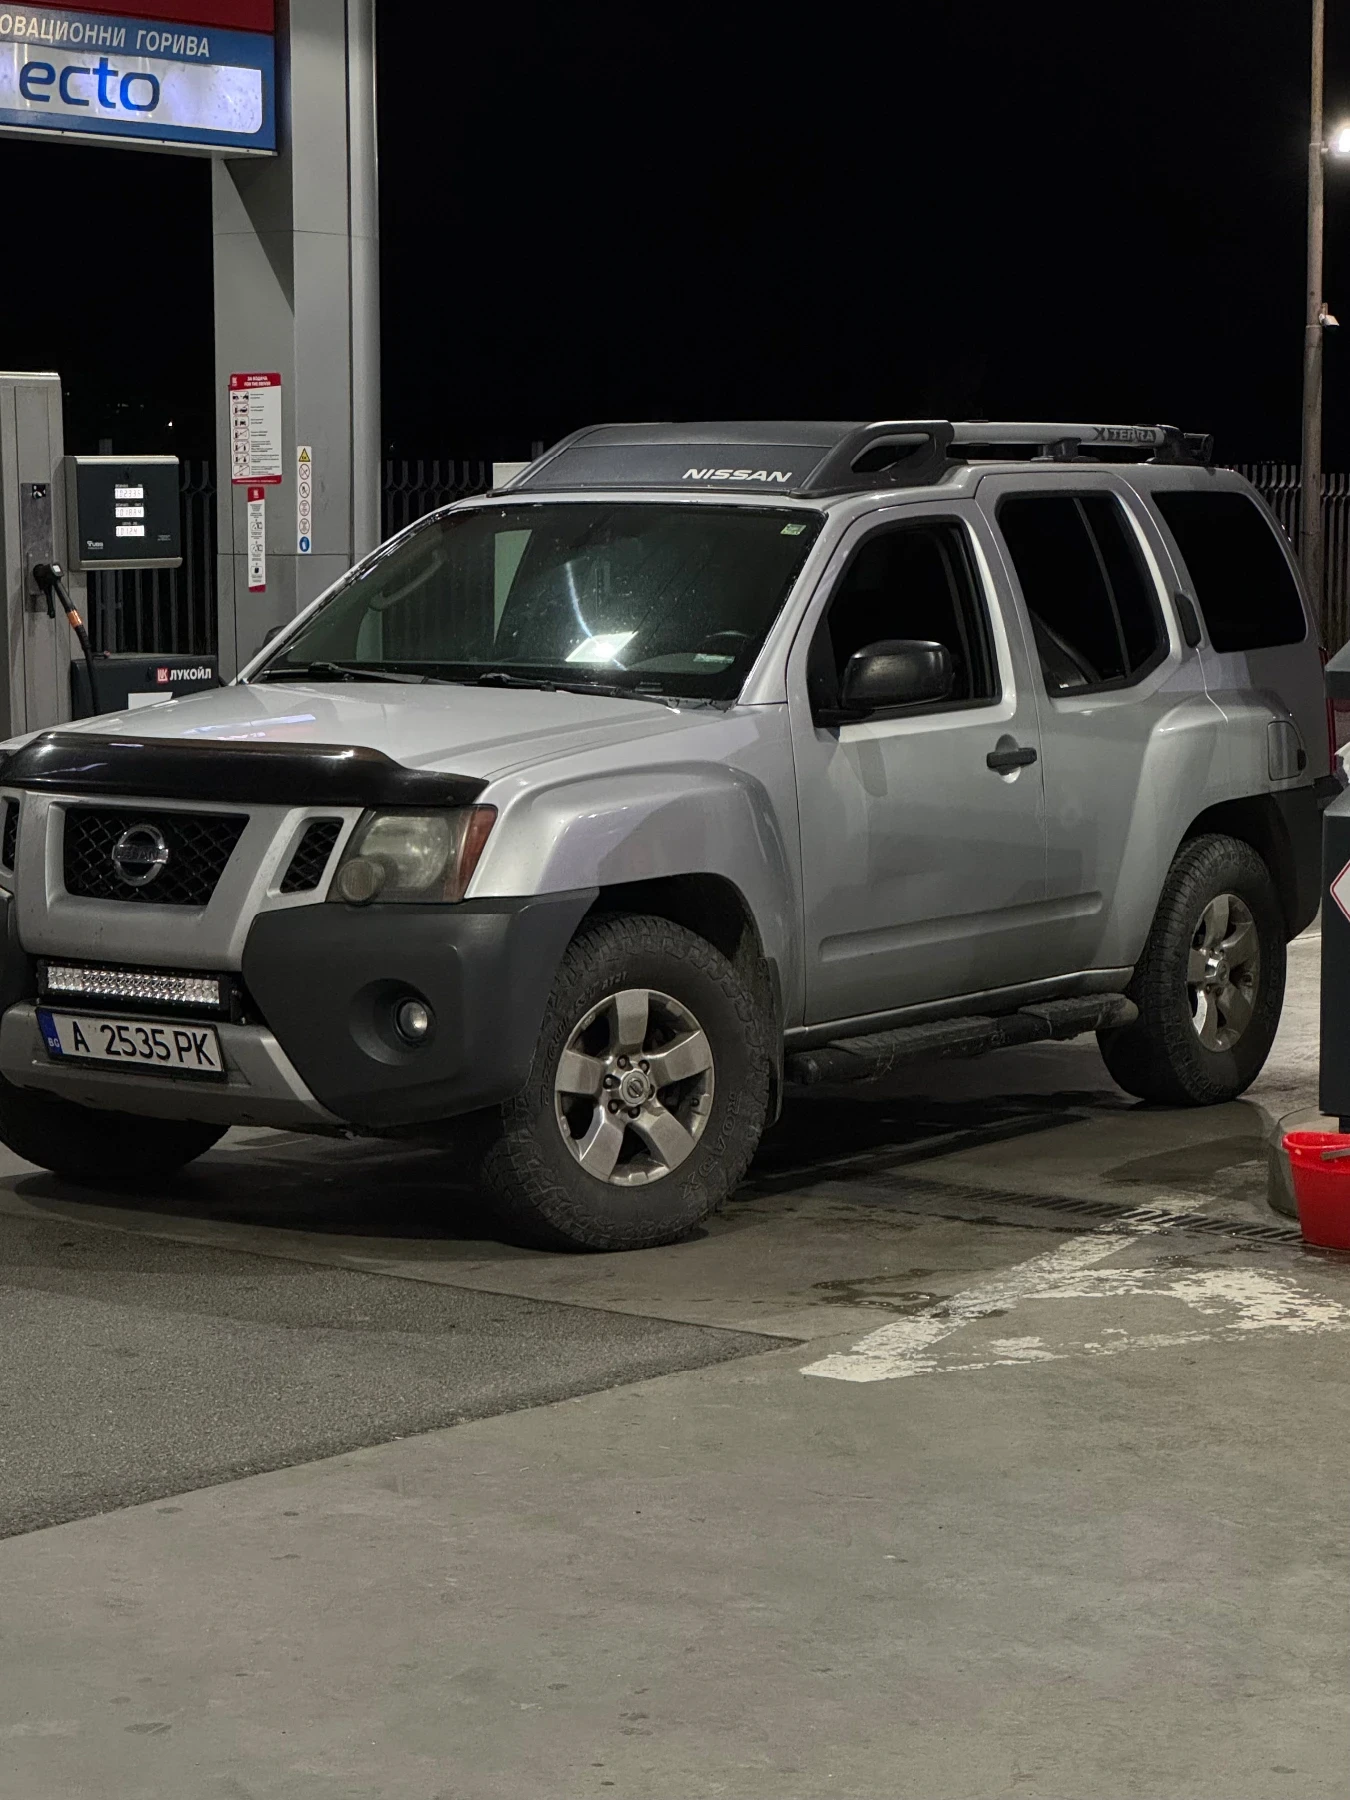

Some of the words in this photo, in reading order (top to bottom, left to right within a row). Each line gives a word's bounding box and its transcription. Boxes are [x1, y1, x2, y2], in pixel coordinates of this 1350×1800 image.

[136, 29, 210, 58] ГОРИВА
[19, 57, 160, 112] ecto
[1092, 427, 1156, 442] XTERRA
[682, 468, 793, 483] NISSAN
[170, 666, 212, 680] ЛУКОЙЛ
[47, 1037, 60, 1048] BG
[72, 1021, 91, 1053] A
[100, 1024, 171, 1061] 2535
[172, 1030, 215, 1067] PK
